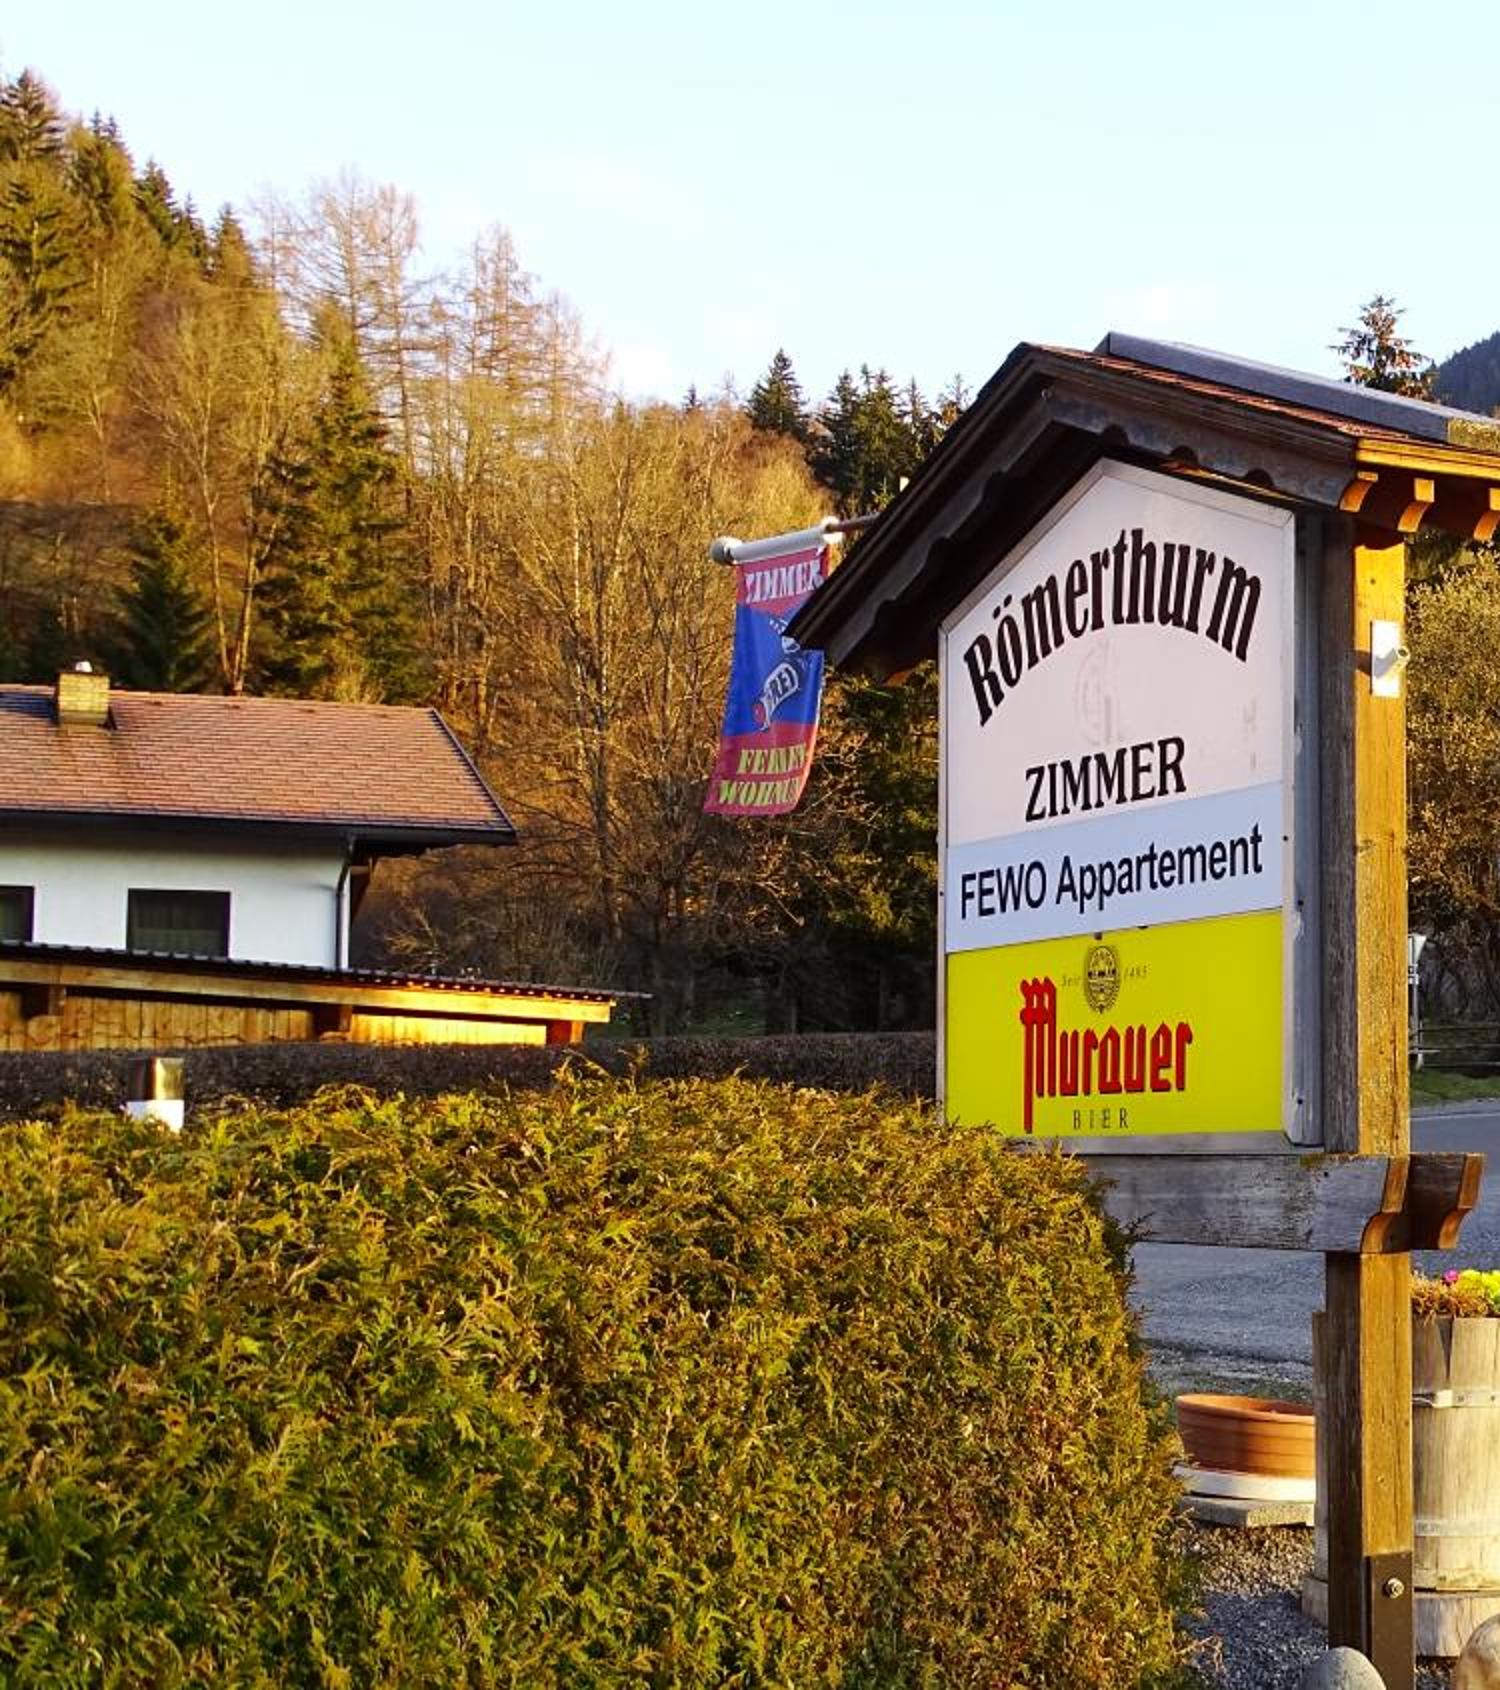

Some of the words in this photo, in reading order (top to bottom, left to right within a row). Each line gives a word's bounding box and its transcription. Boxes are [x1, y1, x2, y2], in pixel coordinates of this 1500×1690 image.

[744, 560, 825, 604] ZIMMER
[963, 527, 1261, 726] Römerthurm
[1024, 736, 1187, 822] ZIMMER
[961, 860, 1047, 919] FEWO
[1055, 823, 1263, 915] Appartement
[1019, 976, 1193, 1134] Murauer
[1072, 1107, 1129, 1129] BIER
